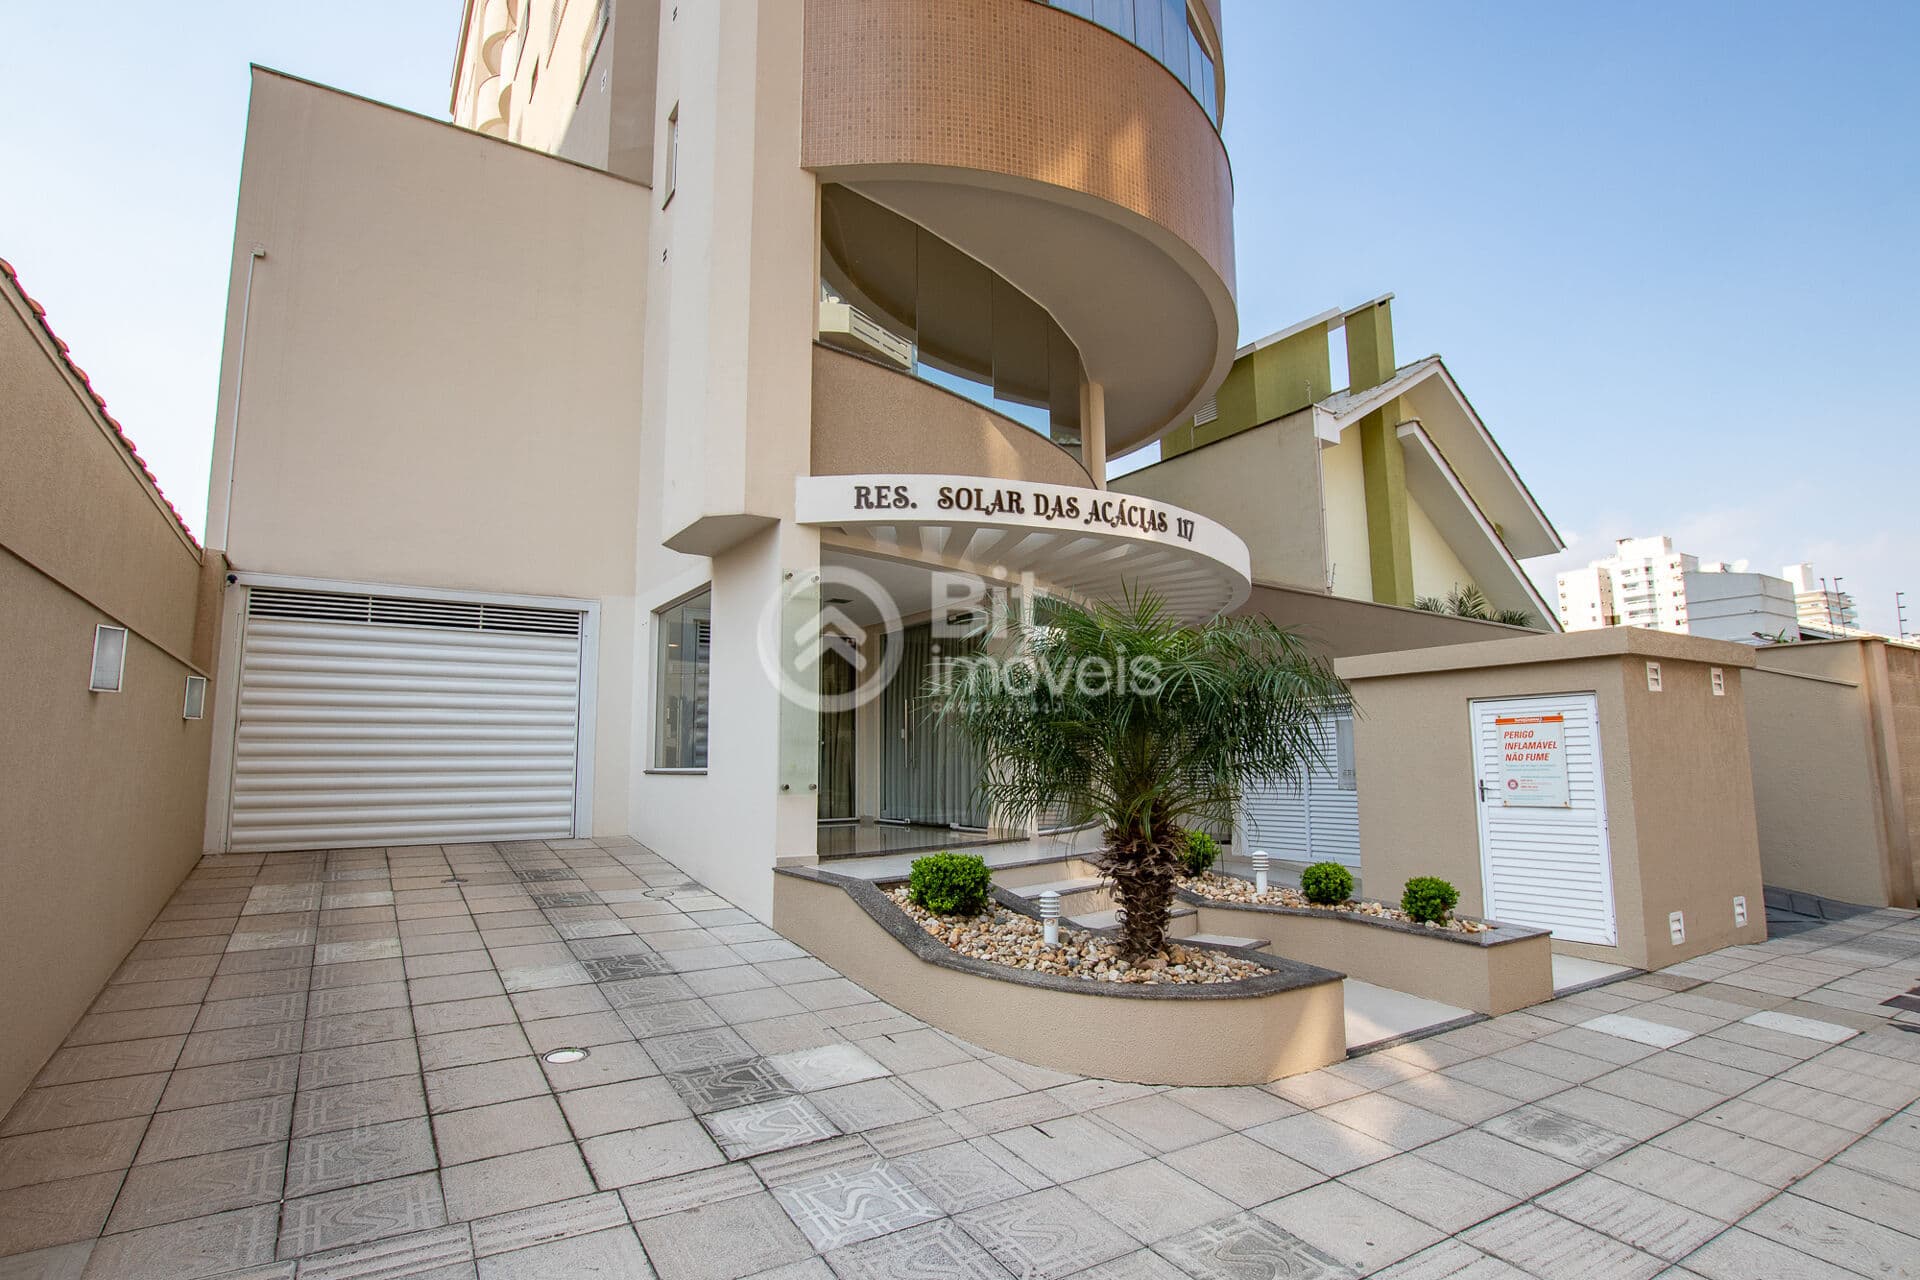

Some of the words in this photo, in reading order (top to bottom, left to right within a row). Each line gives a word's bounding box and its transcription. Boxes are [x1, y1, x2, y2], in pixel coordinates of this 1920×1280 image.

[854, 485, 918, 510] RES.
[937, 487, 1025, 516] SOLAR
[1033, 493, 1080, 521] DAS
[1084, 498, 1168, 533] ACÁCIAS
[1177, 516, 1195, 542] 117
[1503, 730, 1534, 739] PERIGO
[1505, 752, 1524, 762] NÃO
[1525, 753, 1551, 762] FUME
